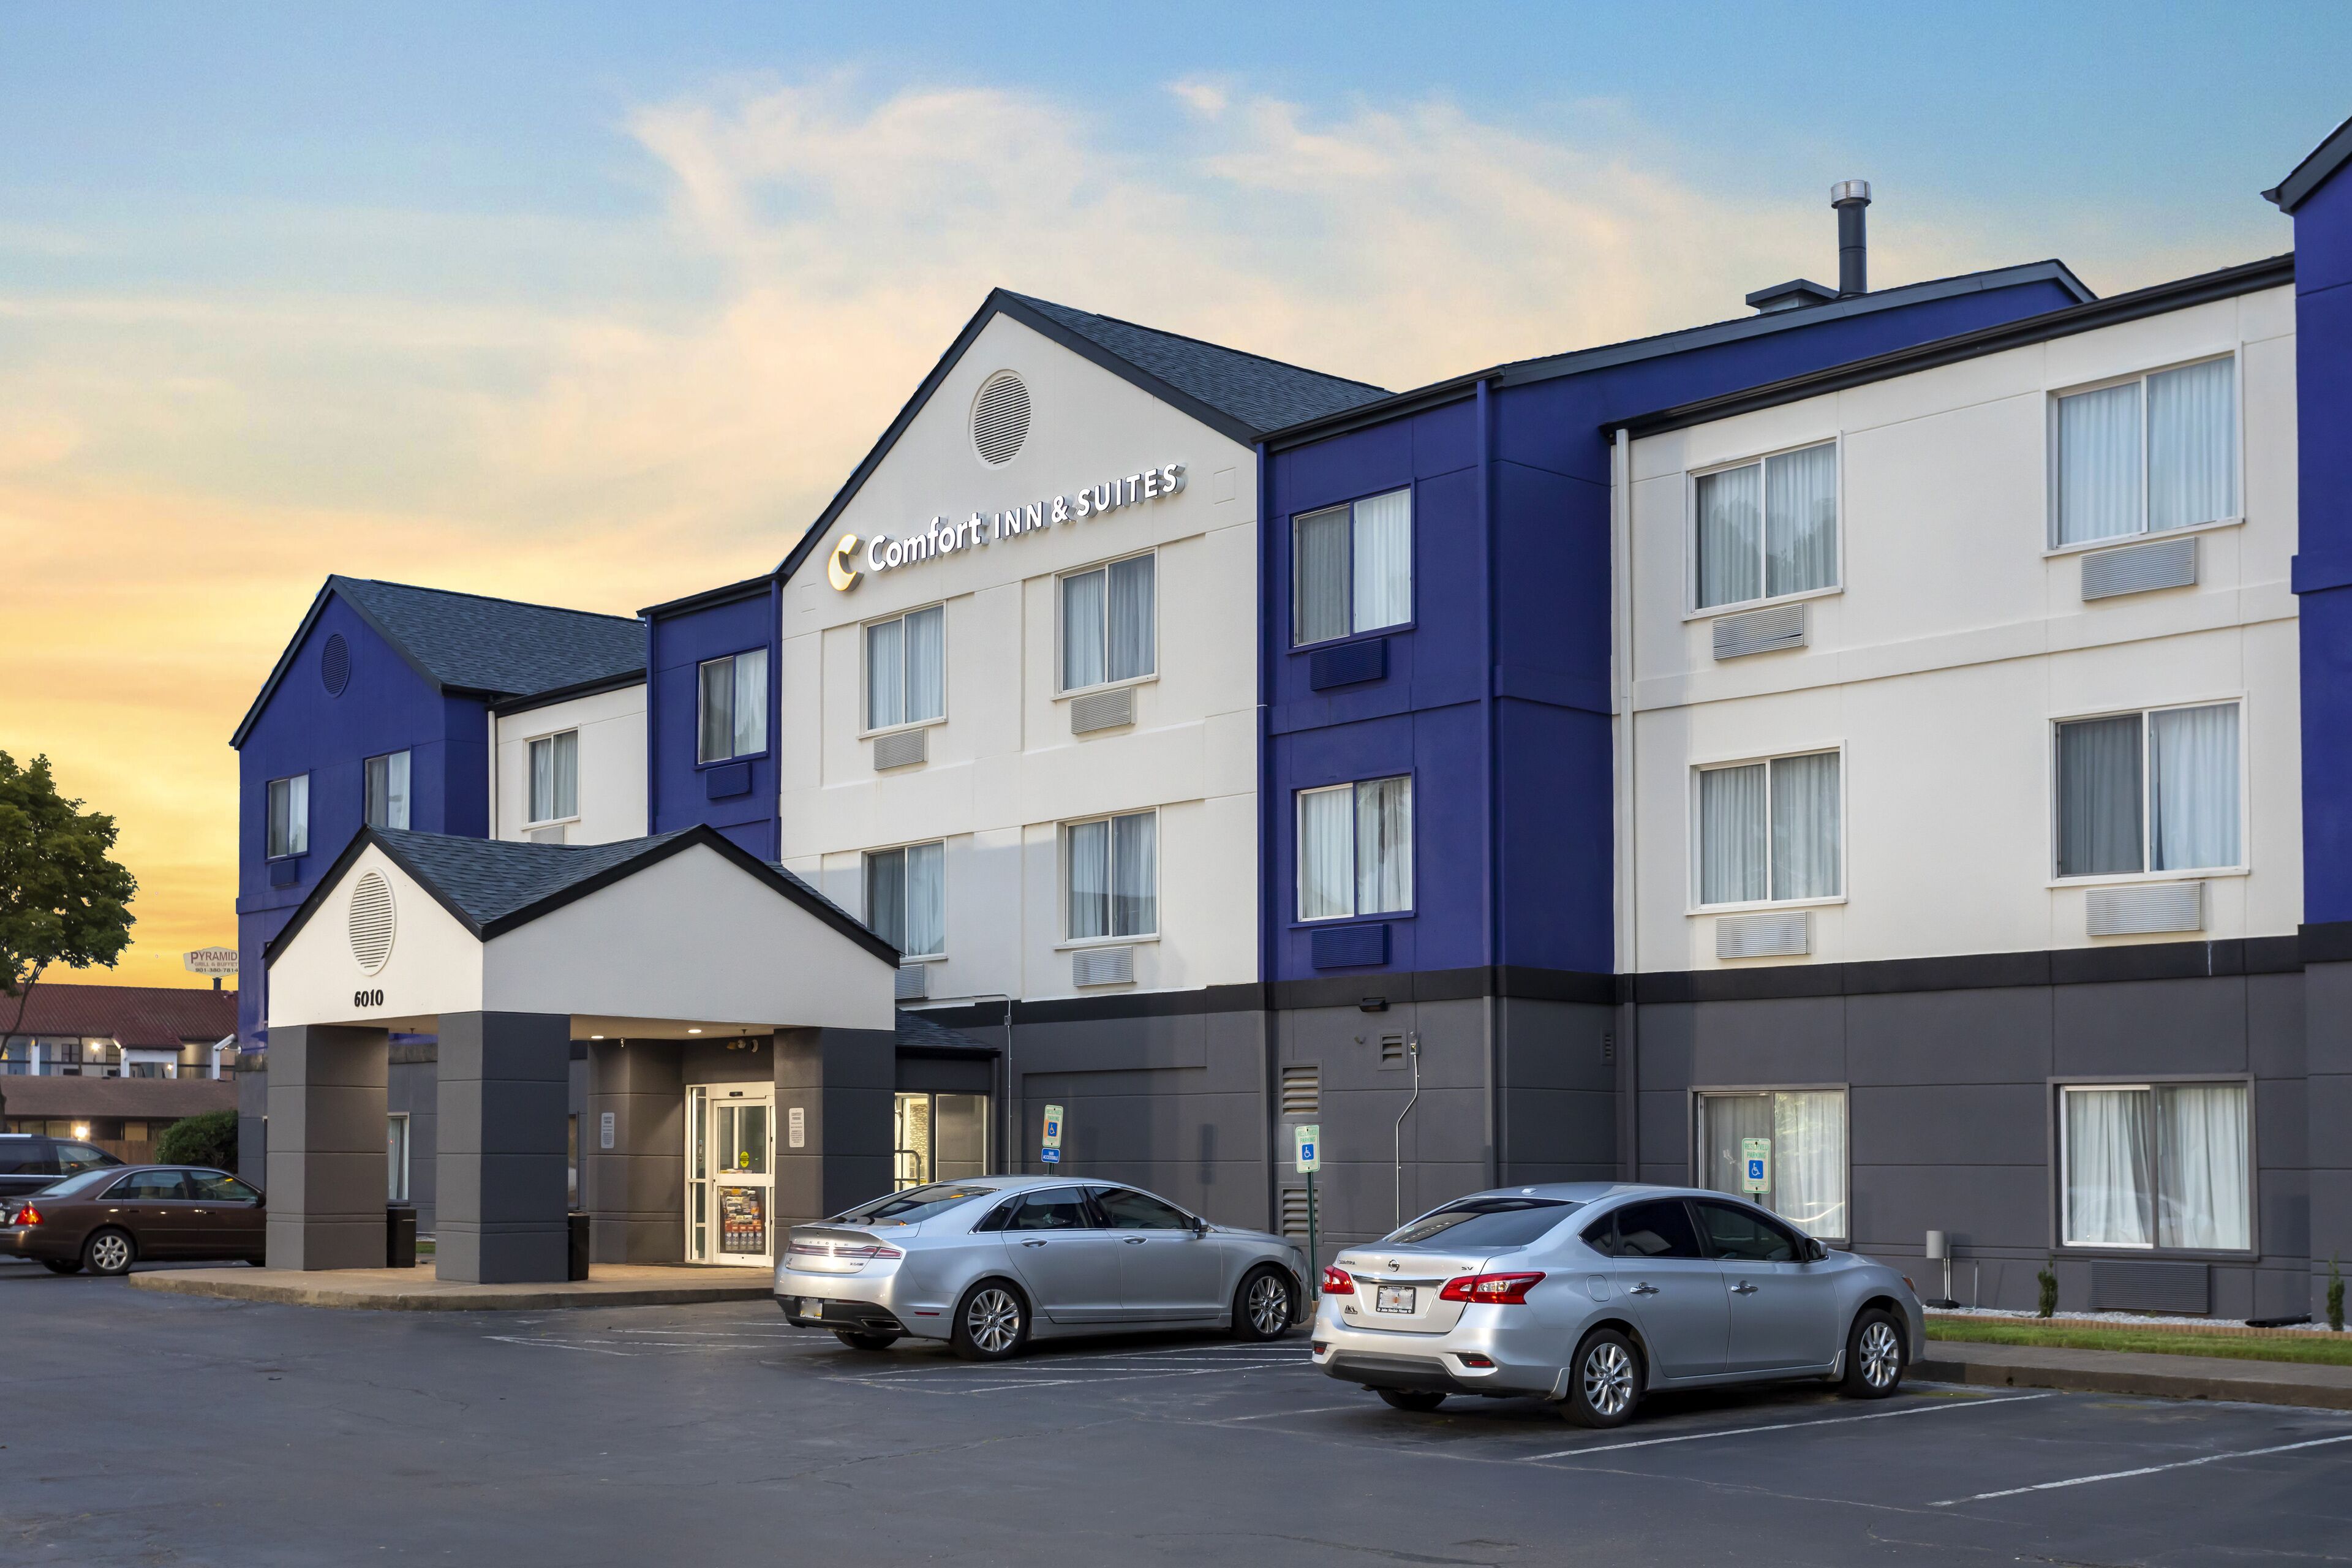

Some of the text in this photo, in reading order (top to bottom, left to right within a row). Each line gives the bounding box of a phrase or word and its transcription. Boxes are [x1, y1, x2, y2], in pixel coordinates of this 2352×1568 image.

[867, 512, 987, 572] Comfort
[994, 501, 1048, 540] INN
[1051, 495, 1072, 523] &
[1076, 463, 1185, 517] SUITES
[190, 952, 238, 963] PYRAMID
[354, 989, 384, 1008] 6010
